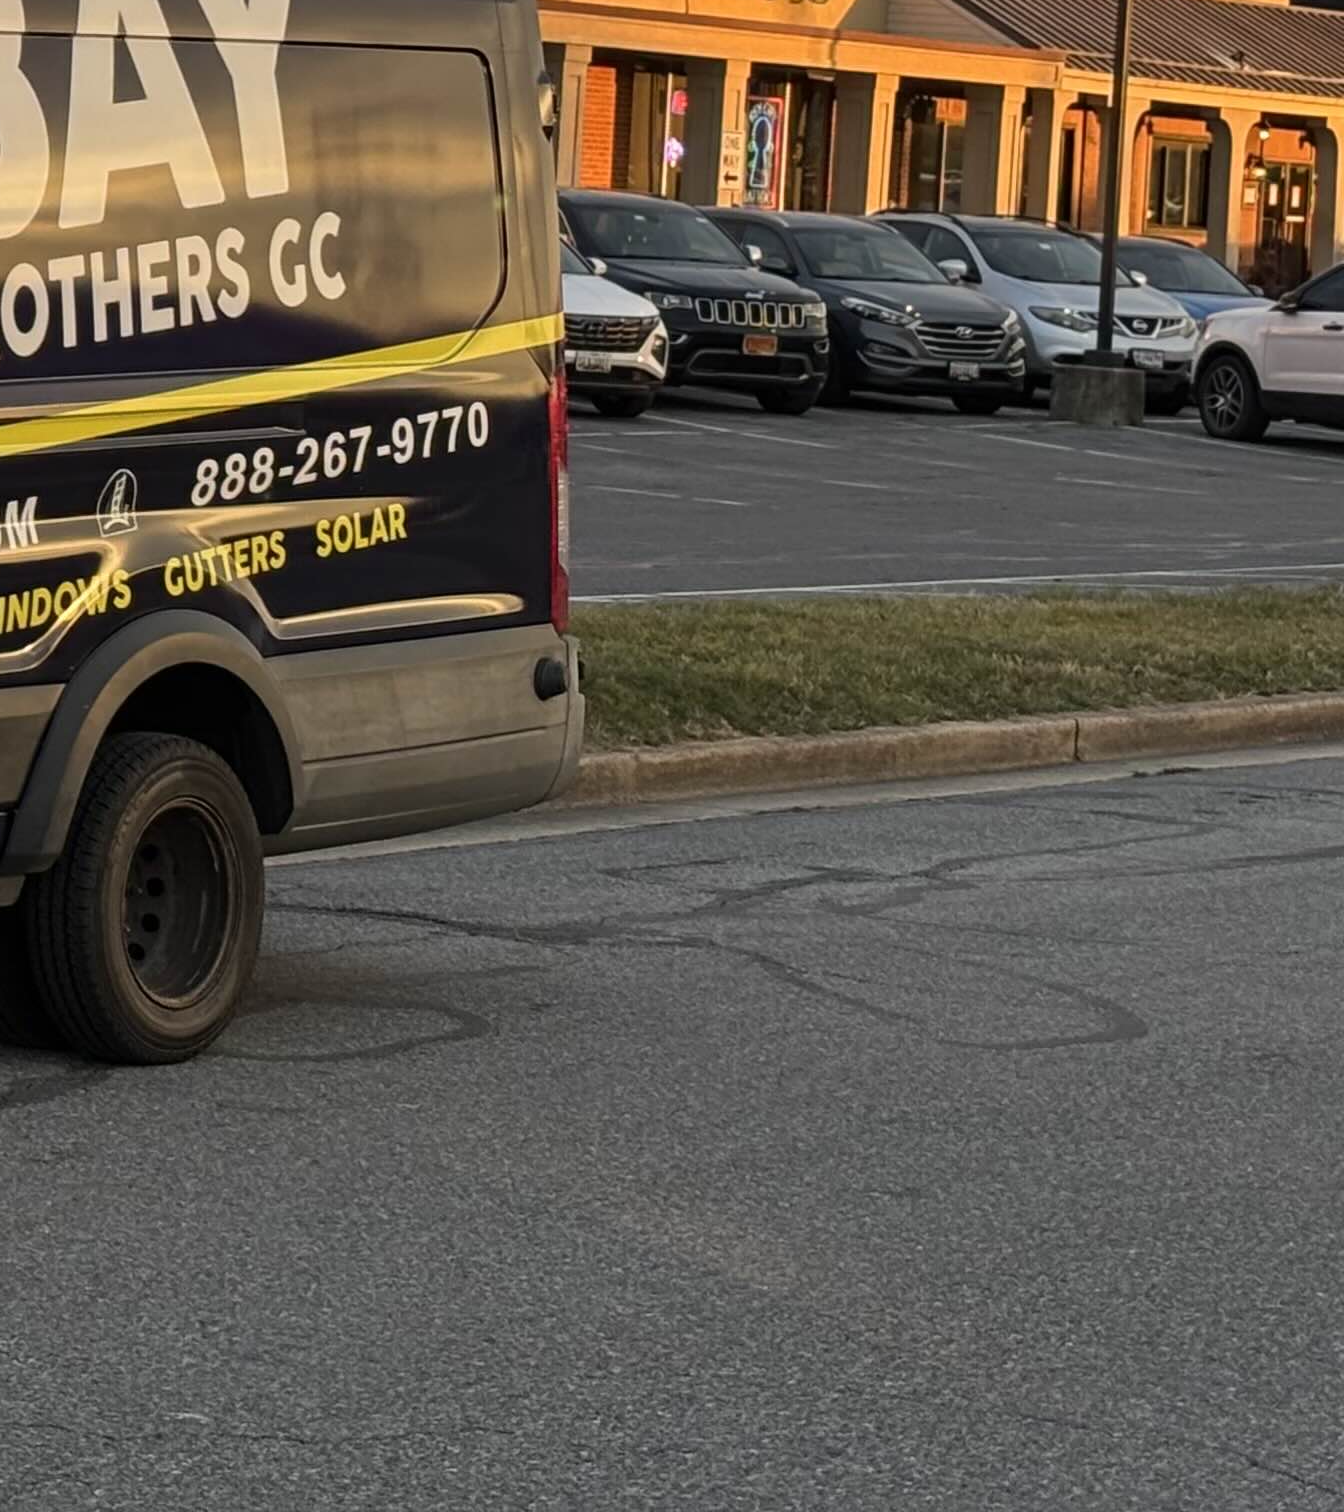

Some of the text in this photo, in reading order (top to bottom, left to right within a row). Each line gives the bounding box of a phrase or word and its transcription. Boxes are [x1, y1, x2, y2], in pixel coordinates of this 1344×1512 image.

[724, 136, 741, 150] ONE
[269, 211, 346, 307] GC
[190, 401, 489, 507] 888-267-9770
[164, 531, 286, 597] GUTTERS
[316, 503, 408, 558] SOLAR
